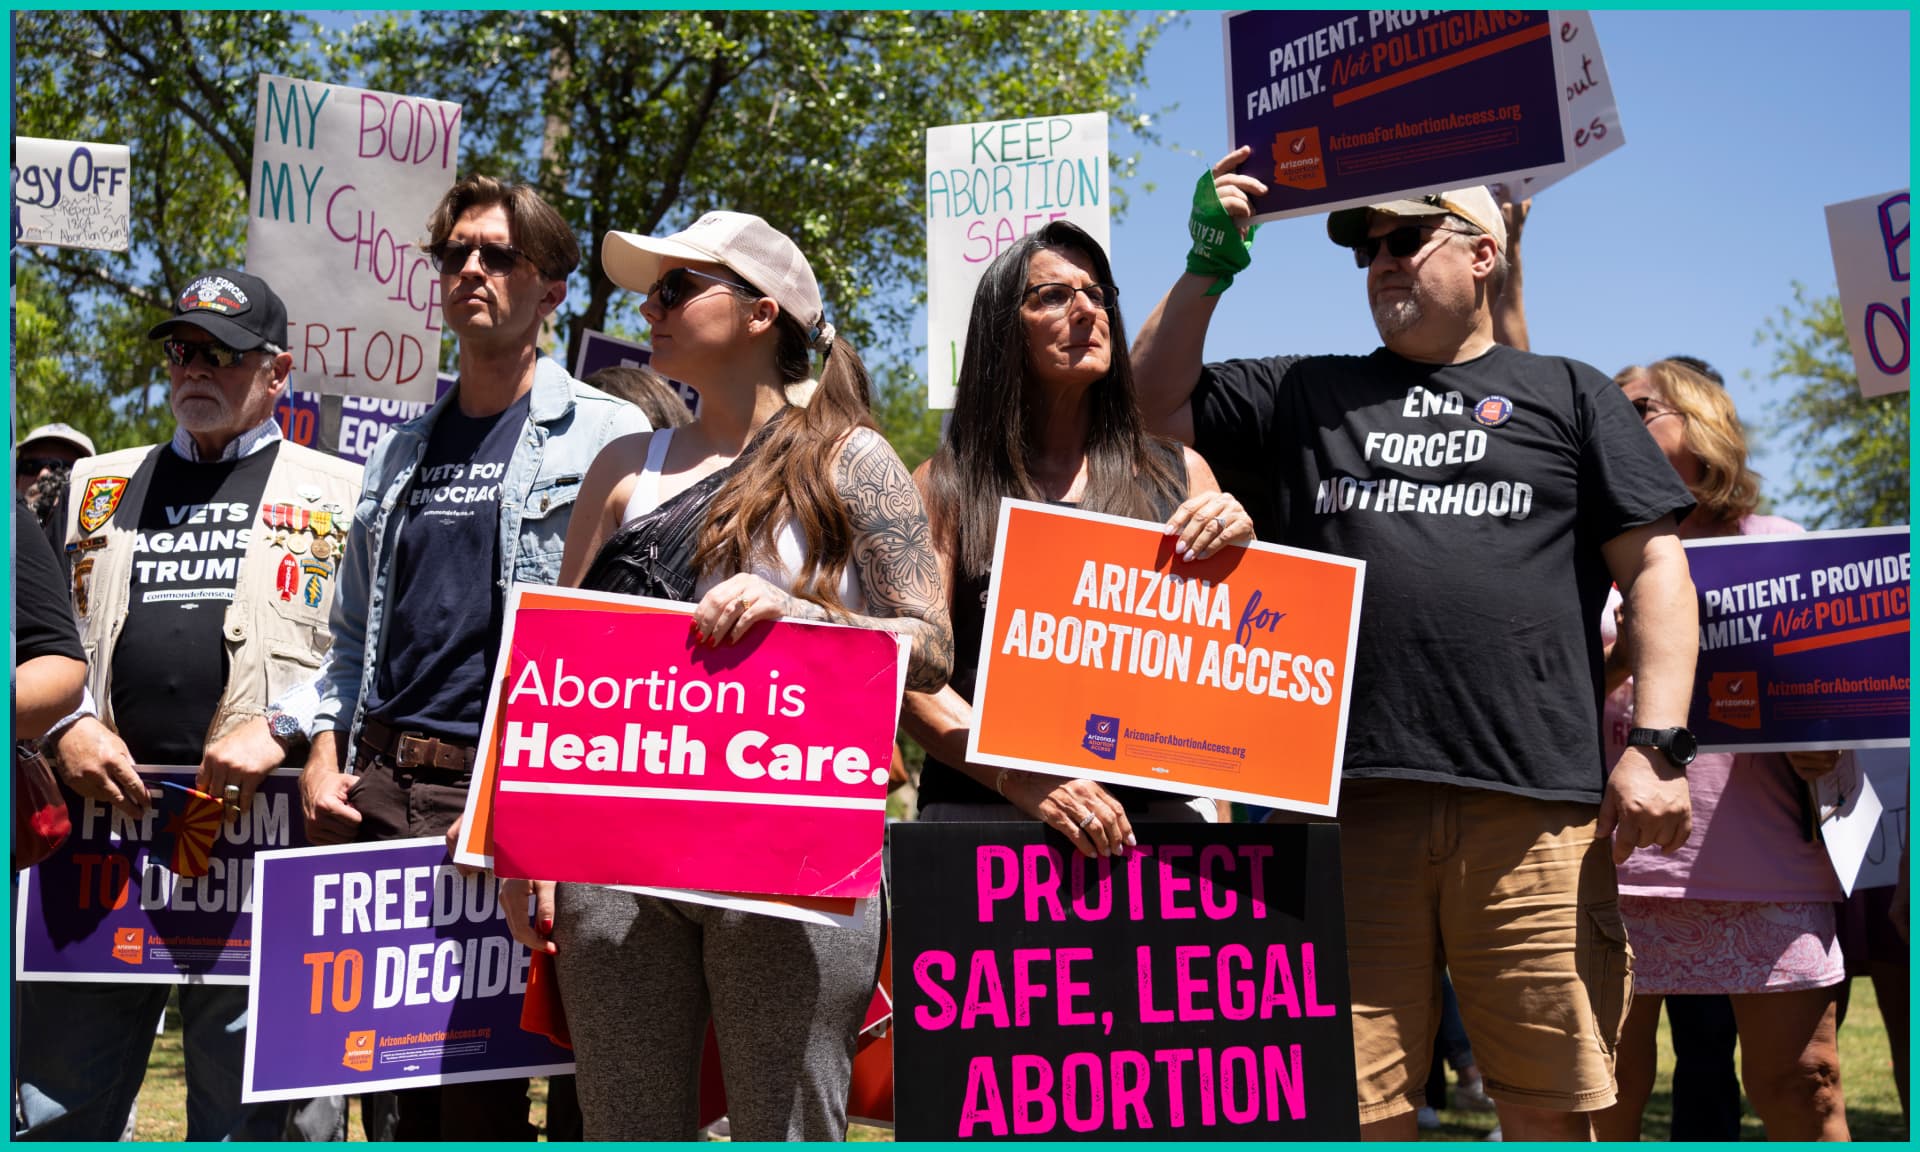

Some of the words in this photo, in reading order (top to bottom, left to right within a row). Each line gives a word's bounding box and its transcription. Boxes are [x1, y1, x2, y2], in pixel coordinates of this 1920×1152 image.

[1270, 16, 1364, 77] PATIENT.
[1247, 65, 1327, 120] FAMILY.
[1331, 52, 1370, 86] Not
[264, 80, 330, 150] MY
[359, 93, 462, 169] BODY
[971, 119, 1073, 164] KEEP
[1329, 104, 1522, 151] ArizonaForAbortionAccess.org
[68, 146, 126, 197] OFF
[930, 156, 1099, 218] ABORTION
[259, 160, 324, 224] MY
[326, 184, 441, 331] CHOICE
[215, 276, 248, 304] FORCES
[1402, 386, 1464, 418] END
[420, 463, 465, 483] VETS
[1364, 429, 1488, 467] FORCED
[165, 503, 249, 526] VETS
[1314, 475, 1533, 520] MOTHERHOOD
[133, 529, 254, 554] AGAINS
[136, 556, 245, 584] TRUM
[1072, 559, 1231, 631] ARIZONA
[1235, 589, 1287, 649] for
[1705, 573, 1806, 618] PATIENT.
[1811, 553, 1910, 598] PROVIDE
[1001, 608, 1193, 683] ABORTION
[1196, 639, 1335, 706] ACCESS
[1698, 613, 1767, 651] AMILY.
[1772, 607, 1813, 637] Not
[508, 658, 746, 715] Abortion
[767, 669, 807, 718] is
[502, 721, 707, 776] Health
[725, 730, 889, 785] Care.
[1123, 728, 1247, 759] ArizonaForAbortionAccess.org
[72, 854, 130, 911] TO
[312, 864, 537, 937] FREEDO
[976, 843, 1275, 923] PROTECT
[303, 949, 364, 1015] TO
[373, 936, 532, 1010] DECIDE
[912, 946, 1115, 1036] SAFE,
[1136, 942, 1337, 1024] LEGAL
[958, 1043, 1307, 1138] ABORTION
